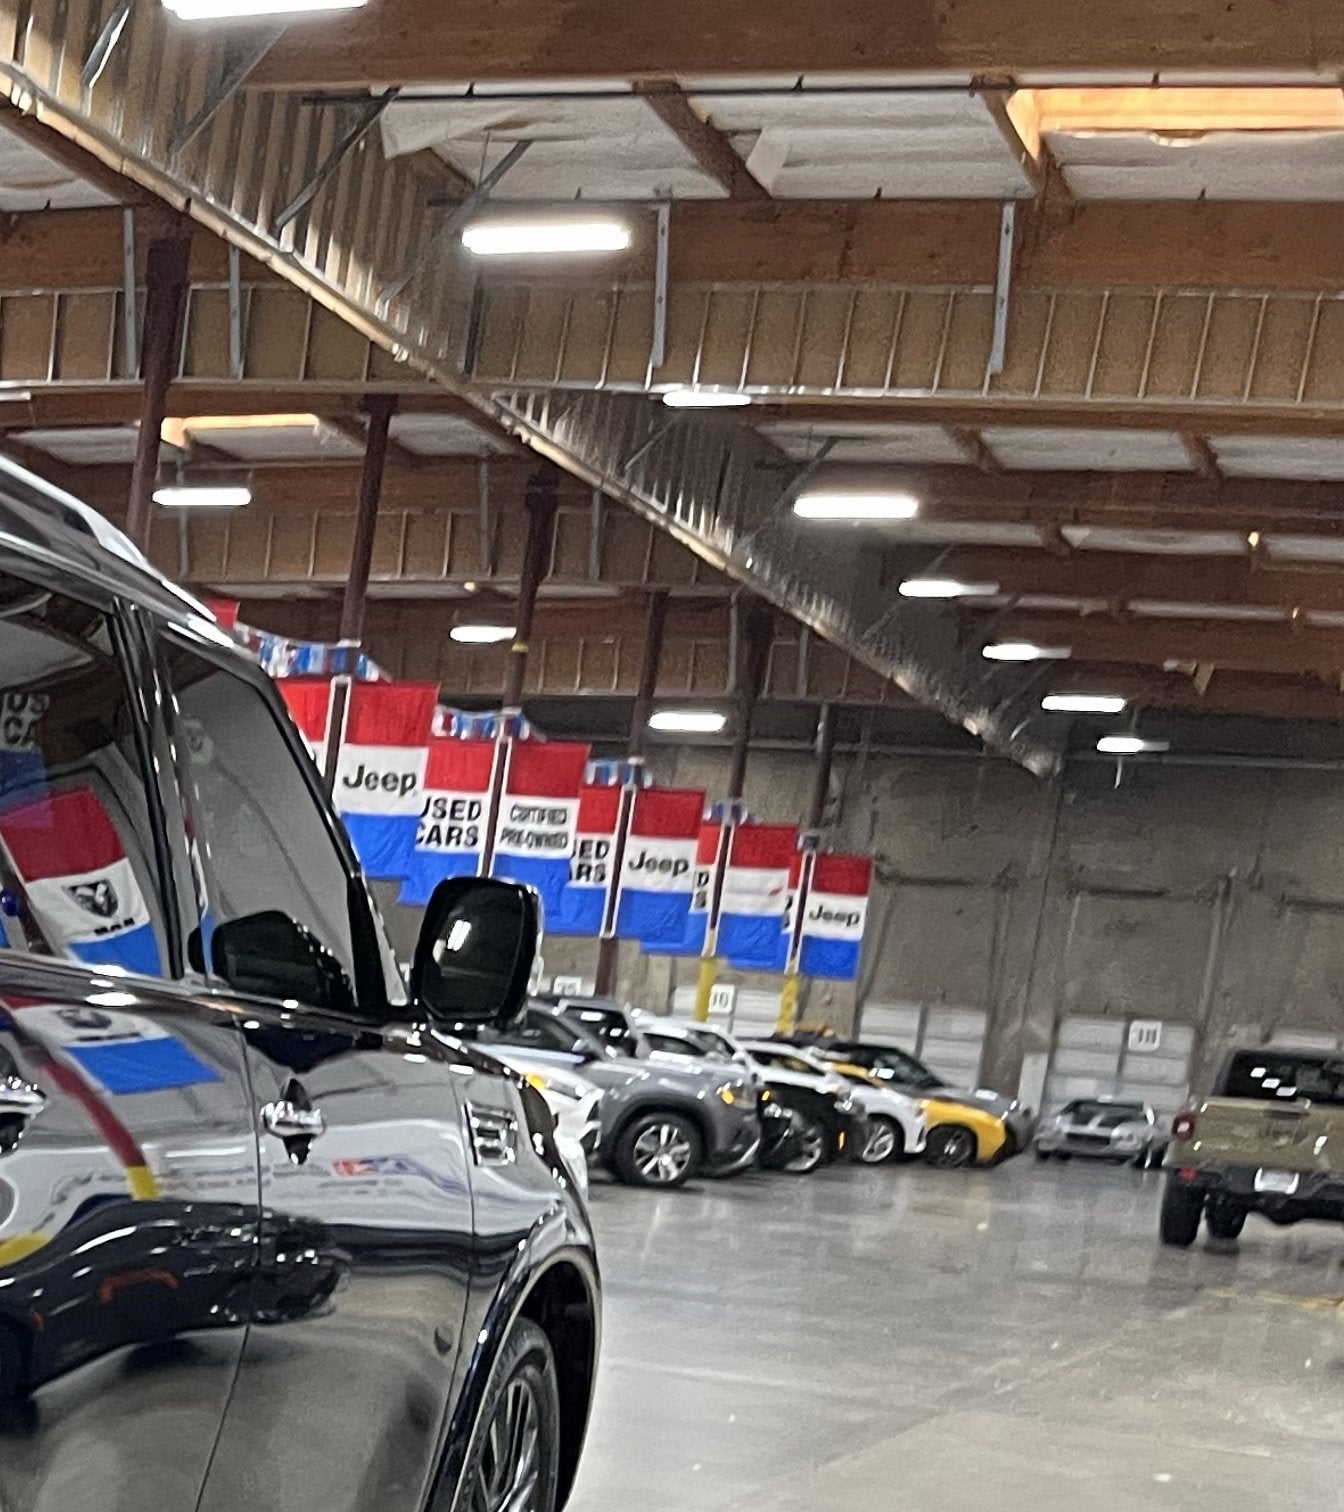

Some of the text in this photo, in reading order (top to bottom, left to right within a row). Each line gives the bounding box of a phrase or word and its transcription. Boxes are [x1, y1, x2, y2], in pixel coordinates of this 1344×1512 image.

[343, 764, 418, 798] Jeep
[628, 849, 689, 878] Jeep
[808, 904, 861, 927] Jeep
